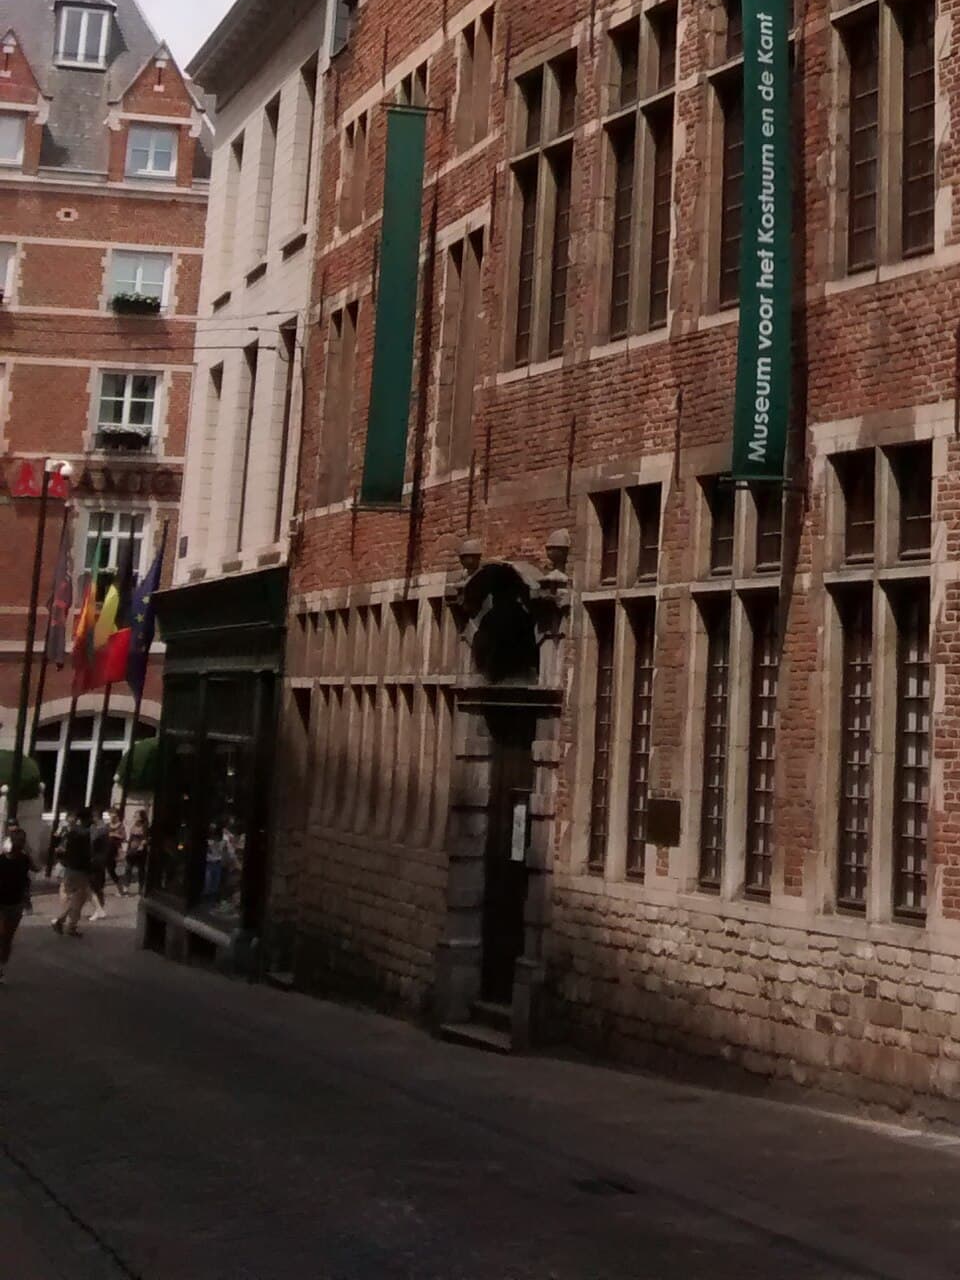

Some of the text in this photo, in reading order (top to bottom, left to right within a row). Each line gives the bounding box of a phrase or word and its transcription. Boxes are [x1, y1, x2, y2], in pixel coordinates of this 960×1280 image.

[747, 11, 775, 463] Museum voor het Kostuum en de Kant
